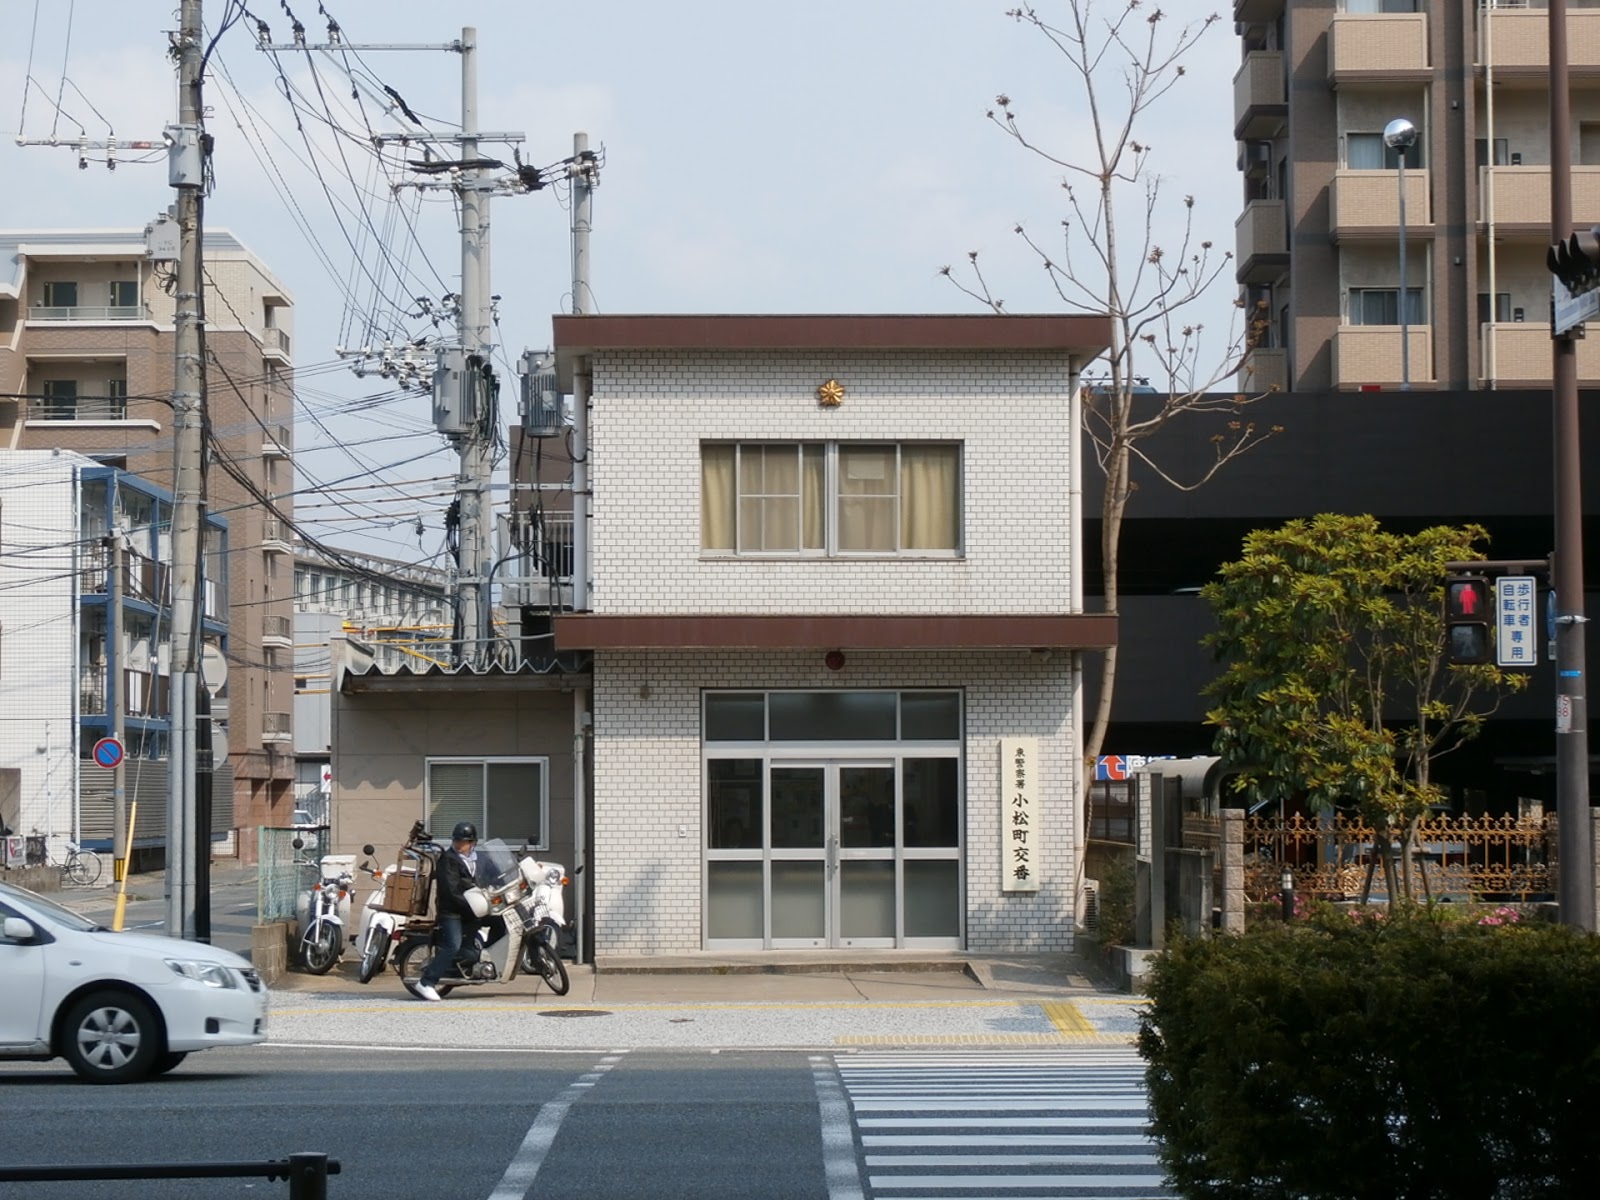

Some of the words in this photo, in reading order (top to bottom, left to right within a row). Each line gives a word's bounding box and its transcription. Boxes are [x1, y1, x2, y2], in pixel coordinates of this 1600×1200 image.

[1503, 584, 1515, 626] 自転車
[1517, 584, 1530, 626] 歩行者
[1511, 630, 1523, 659] 専用
[1014, 747, 1026, 790] 東警察署
[1012, 793, 1030, 880] 小松町交番
